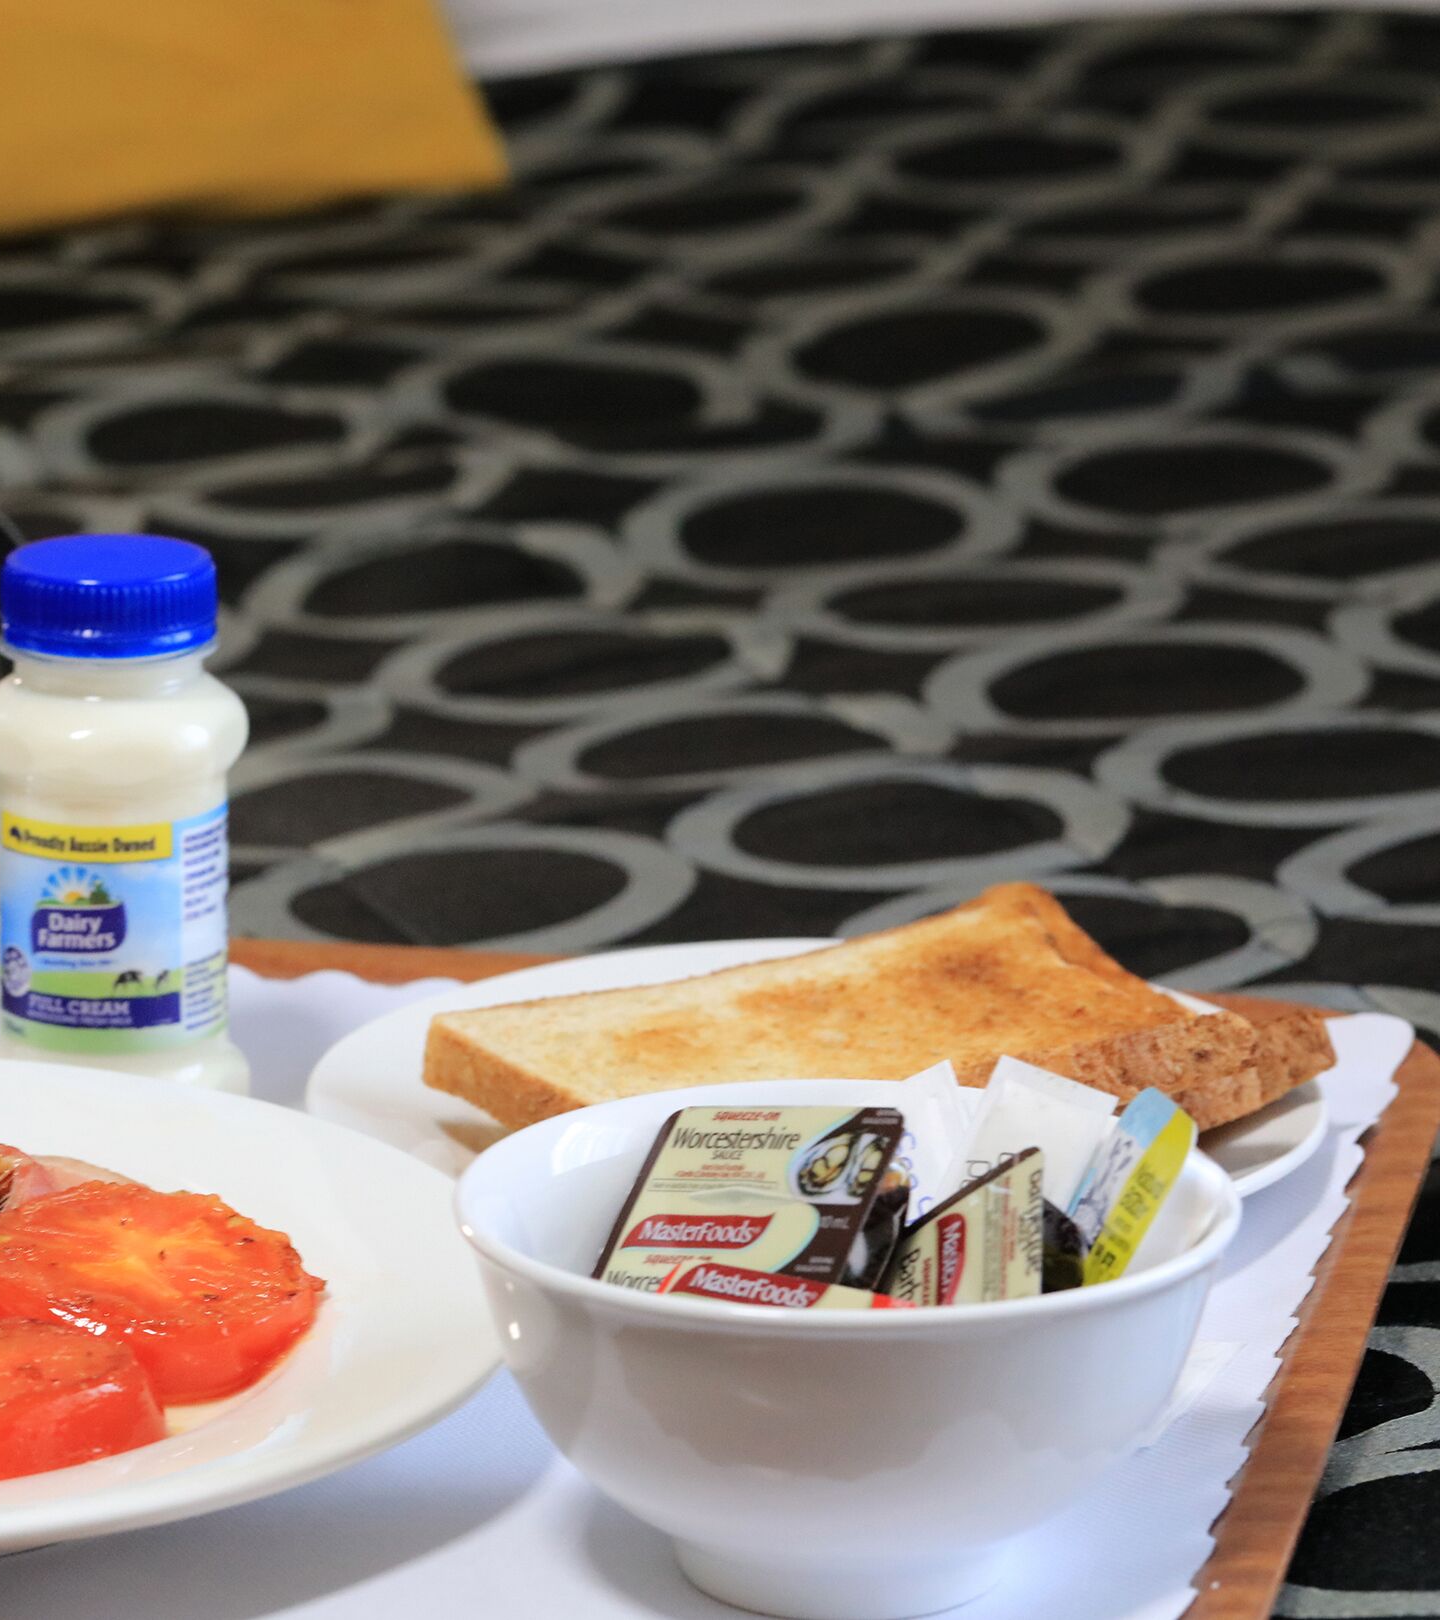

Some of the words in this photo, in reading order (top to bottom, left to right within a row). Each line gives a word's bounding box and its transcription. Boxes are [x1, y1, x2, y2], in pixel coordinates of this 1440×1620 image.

[23, 829, 65, 851] Proudly
[70, 836, 108, 852] Aussie
[113, 835, 156, 852] Owned
[48, 912, 103, 934] Dairy
[38, 928, 116, 949] Farmers
[29, 994, 65, 1013] FULL
[66, 1001, 131, 1016] CREAM
[671, 1126, 802, 1151] Worcestershire
[710, 1150, 744, 1160] SAUCE
[637, 1219, 760, 1244] MasterFoods
[688, 1266, 817, 1308] MasterFoods
